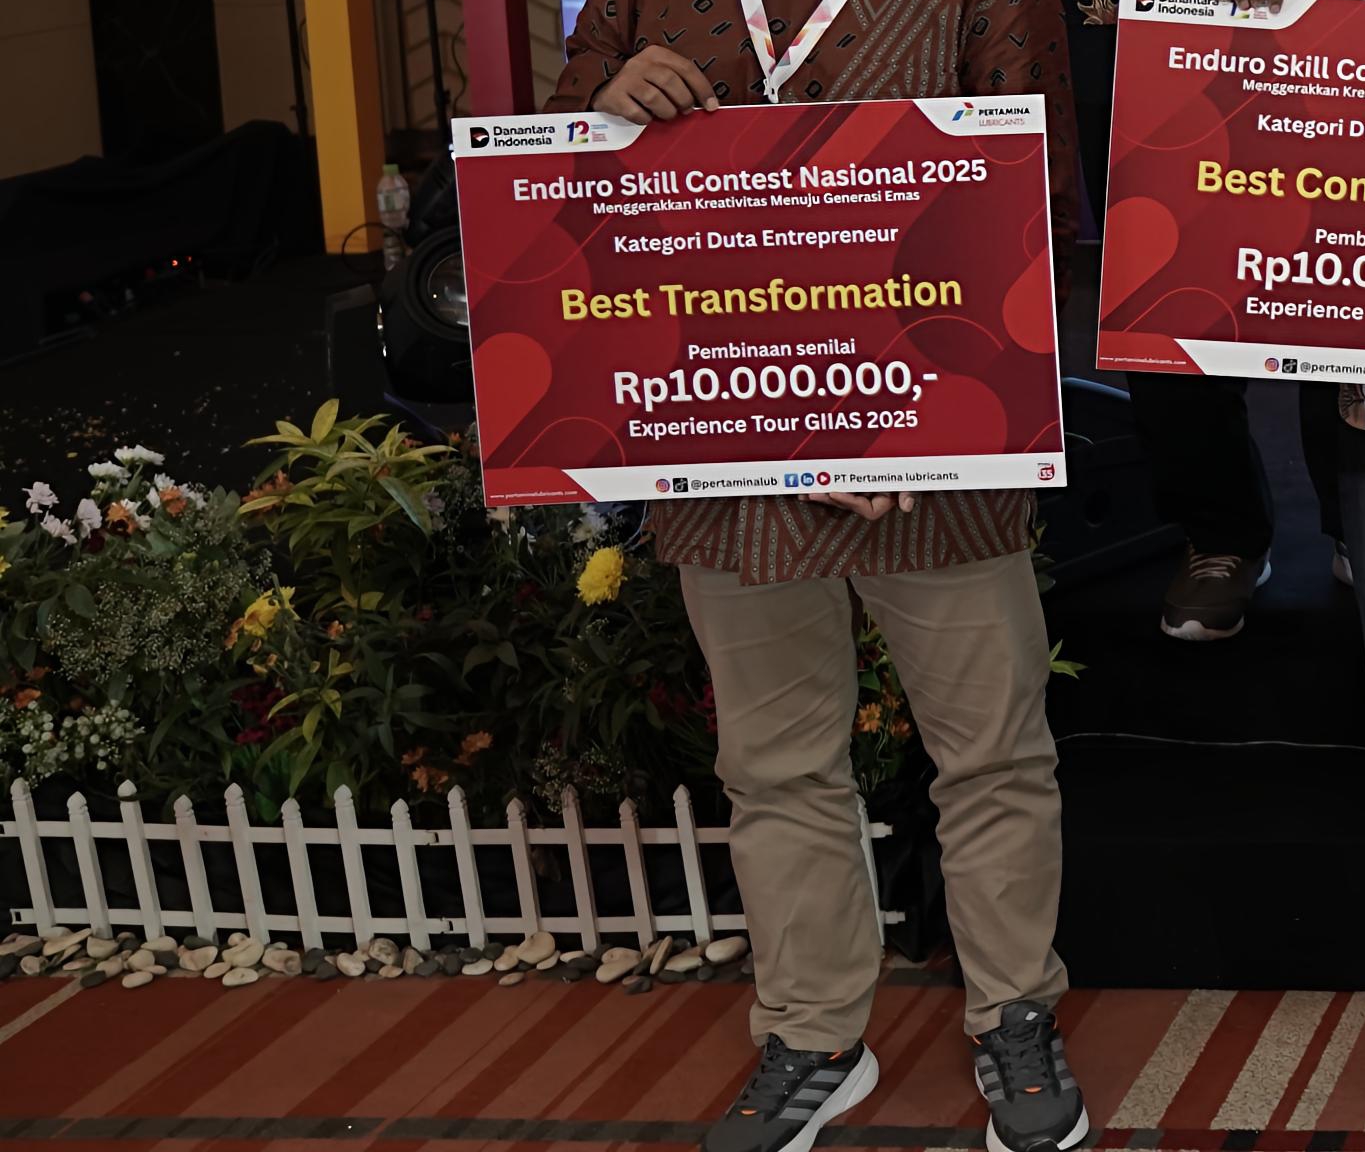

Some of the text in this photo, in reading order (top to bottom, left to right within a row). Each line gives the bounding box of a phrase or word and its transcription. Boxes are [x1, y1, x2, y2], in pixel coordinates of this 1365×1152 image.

[1169, 47, 1265, 74] Enduro
[1273, 55, 1329, 79] Skill
[979, 108, 1030, 116] PERTAMINA
[493, 126, 555, 136] Danantara
[494, 135, 552, 147] Indonesia
[514, 159, 987, 200] Enduro Skill Contest Nasional 2025
[1198, 161, 1285, 196] Best
[562, 274, 961, 320] Best Transformation
[1247, 297, 1363, 320] Experience
[689, 338, 855, 359] Pembinaan senilai
[614, 361, 937, 412] Rp10.000.000,-
[629, 410, 917, 440] Experience Tour GIIAS 2025
